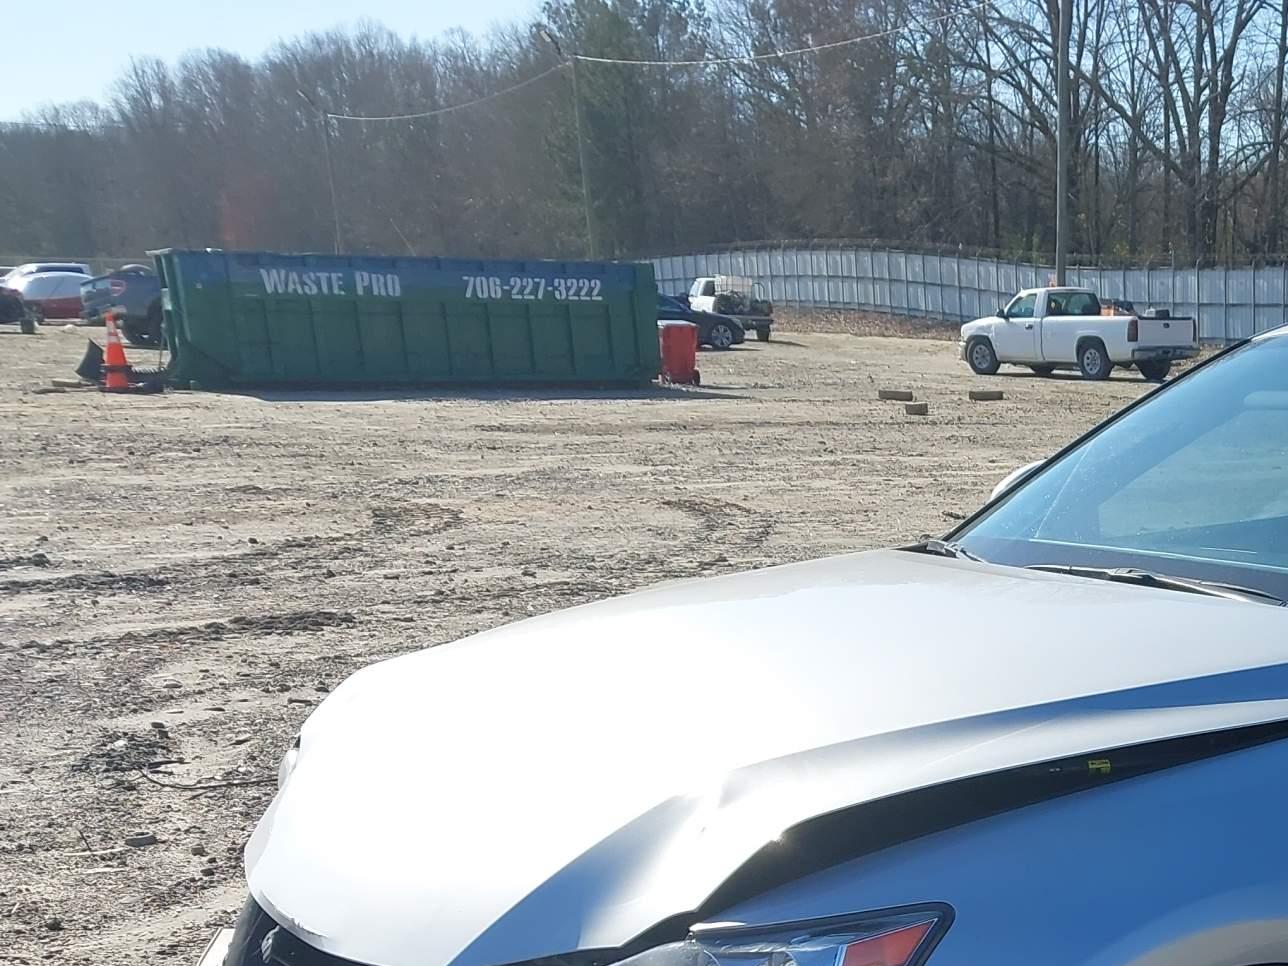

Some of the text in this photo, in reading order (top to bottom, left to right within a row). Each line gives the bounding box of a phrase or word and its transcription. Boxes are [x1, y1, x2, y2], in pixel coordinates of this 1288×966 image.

[259, 268, 401, 297] WASTE PRO
[462, 275, 603, 301] 706-227-3222
